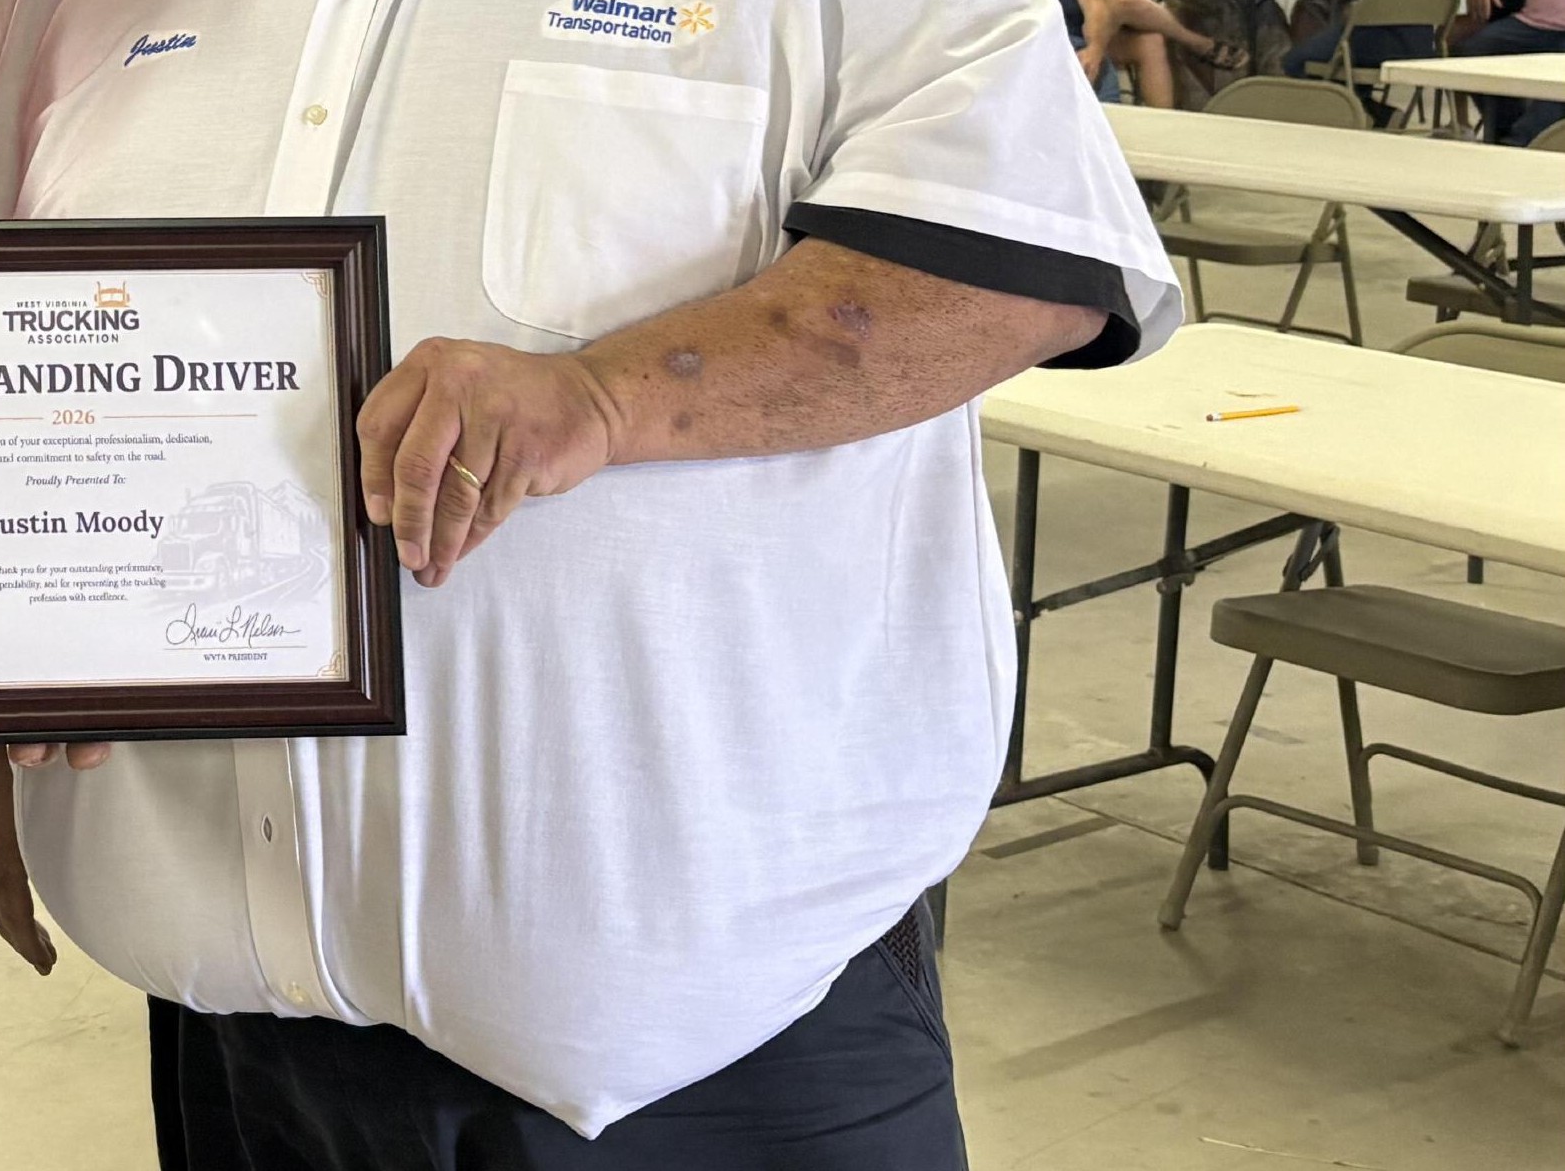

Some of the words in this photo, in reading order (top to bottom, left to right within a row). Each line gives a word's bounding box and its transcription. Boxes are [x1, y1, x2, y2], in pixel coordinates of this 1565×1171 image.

[547, 11, 672, 44] Transportation
[124, 33, 197, 67] Justin
[45, 300, 88, 308] VIRGINIA
[2, 309, 140, 332] TRUCKING
[27, 333, 119, 345] ASSOCIATION
[152, 354, 300, 393] DRIVER
[51, 409, 96, 426] 2026
[8, 435, 19, 447] of
[20, 437, 40, 448] your
[42, 434, 93, 448] exceptional
[95, 433, 163, 448] professionalism,
[165, 433, 213, 446] dedication,
[17, 452, 72, 462] commitment
[74, 452, 84, 462] to
[86, 450, 111, 463] safety
[113, 454, 125, 462] on
[127, 451, 142, 462] the
[144, 451, 166, 462] road.
[25, 474, 62, 487] Proudly
[65, 474, 110, 485] Presented
[112, 473, 126, 485] To:
[75, 509, 165, 539] Moody
[20, 568, 34, 576] you
[36, 565, 47, 574] for
[49, 567, 67, 576] your
[69, 564, 114, 575] outstanding
[115, 563, 164, 575] performance,
[44, 579, 58, 589] and
[60, 579, 70, 588] for
[72, 579, 119, 590] representing
[120, 578, 132, 587] the
[134, 577, 166, 589] trucking
[29, 594, 67, 605] profession
[69, 593, 86, 602] with
[240, 612, 301, 648] Nelson
[228, 653, 268, 661] PRESIDENT
